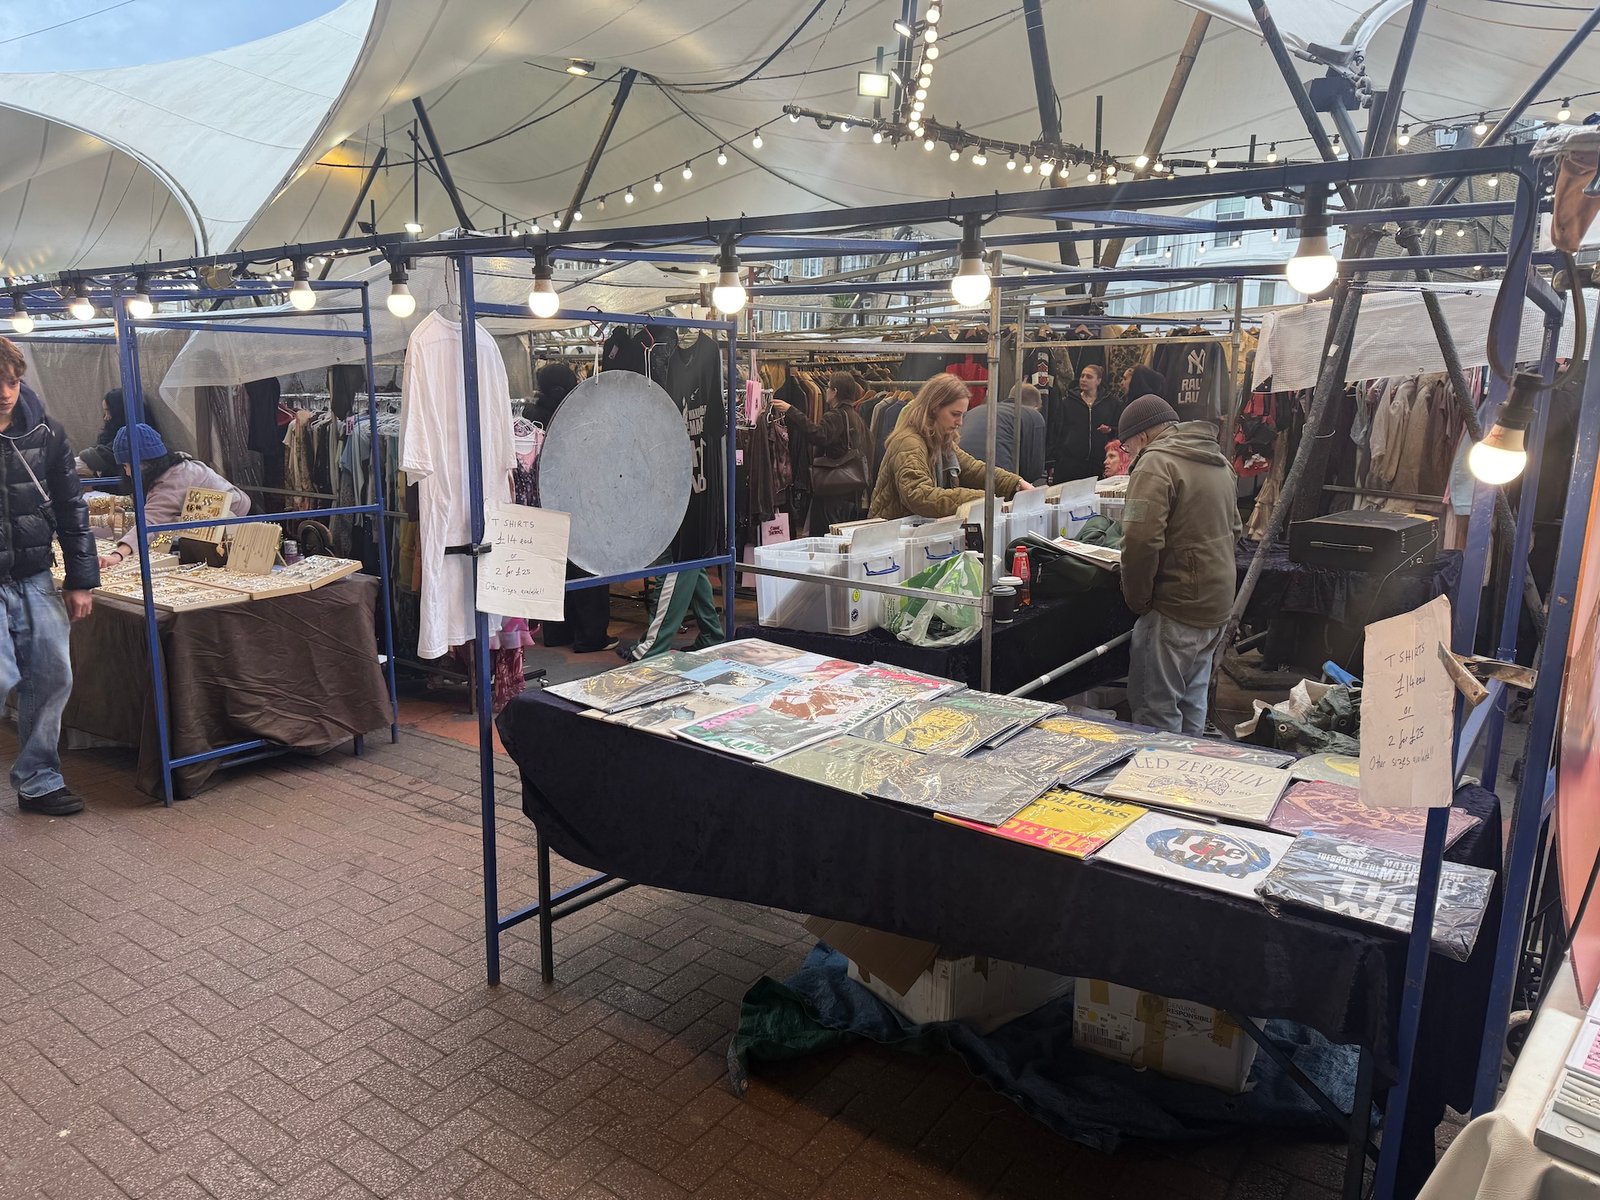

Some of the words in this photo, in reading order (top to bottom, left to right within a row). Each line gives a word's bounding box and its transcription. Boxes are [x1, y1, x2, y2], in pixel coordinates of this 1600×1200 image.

[1181, 378, 1201, 391] RAL
[1177, 391, 1200, 405] LAU
[491, 518, 500, 527] T
[503, 519, 535, 529] SHIRTS
[495, 532, 517, 545] £14
[495, 567, 502, 576] 2
[505, 565, 515, 578] for
[515, 566, 532, 576] £25
[1384, 653, 1396, 668] T
[1399, 642, 1426, 664] SHIRTS
[725, 660, 748, 670] The
[753, 667, 803, 684] Smiths
[1394, 673, 1415, 699] £14
[1403, 705, 1412, 715] or
[1388, 735, 1396, 747] 2
[1398, 729, 1409, 749] for
[1409, 726, 1425, 745] £25
[1132, 756, 1170, 770] LED
[1177, 758, 1273, 790] ZEPPELIN
[1042, 794, 1131, 819] OLLOCKS
[1173, 828, 1247, 860] The
[1154, 844, 1251, 880] Who
[1383, 858, 1420, 873] MAXIM
